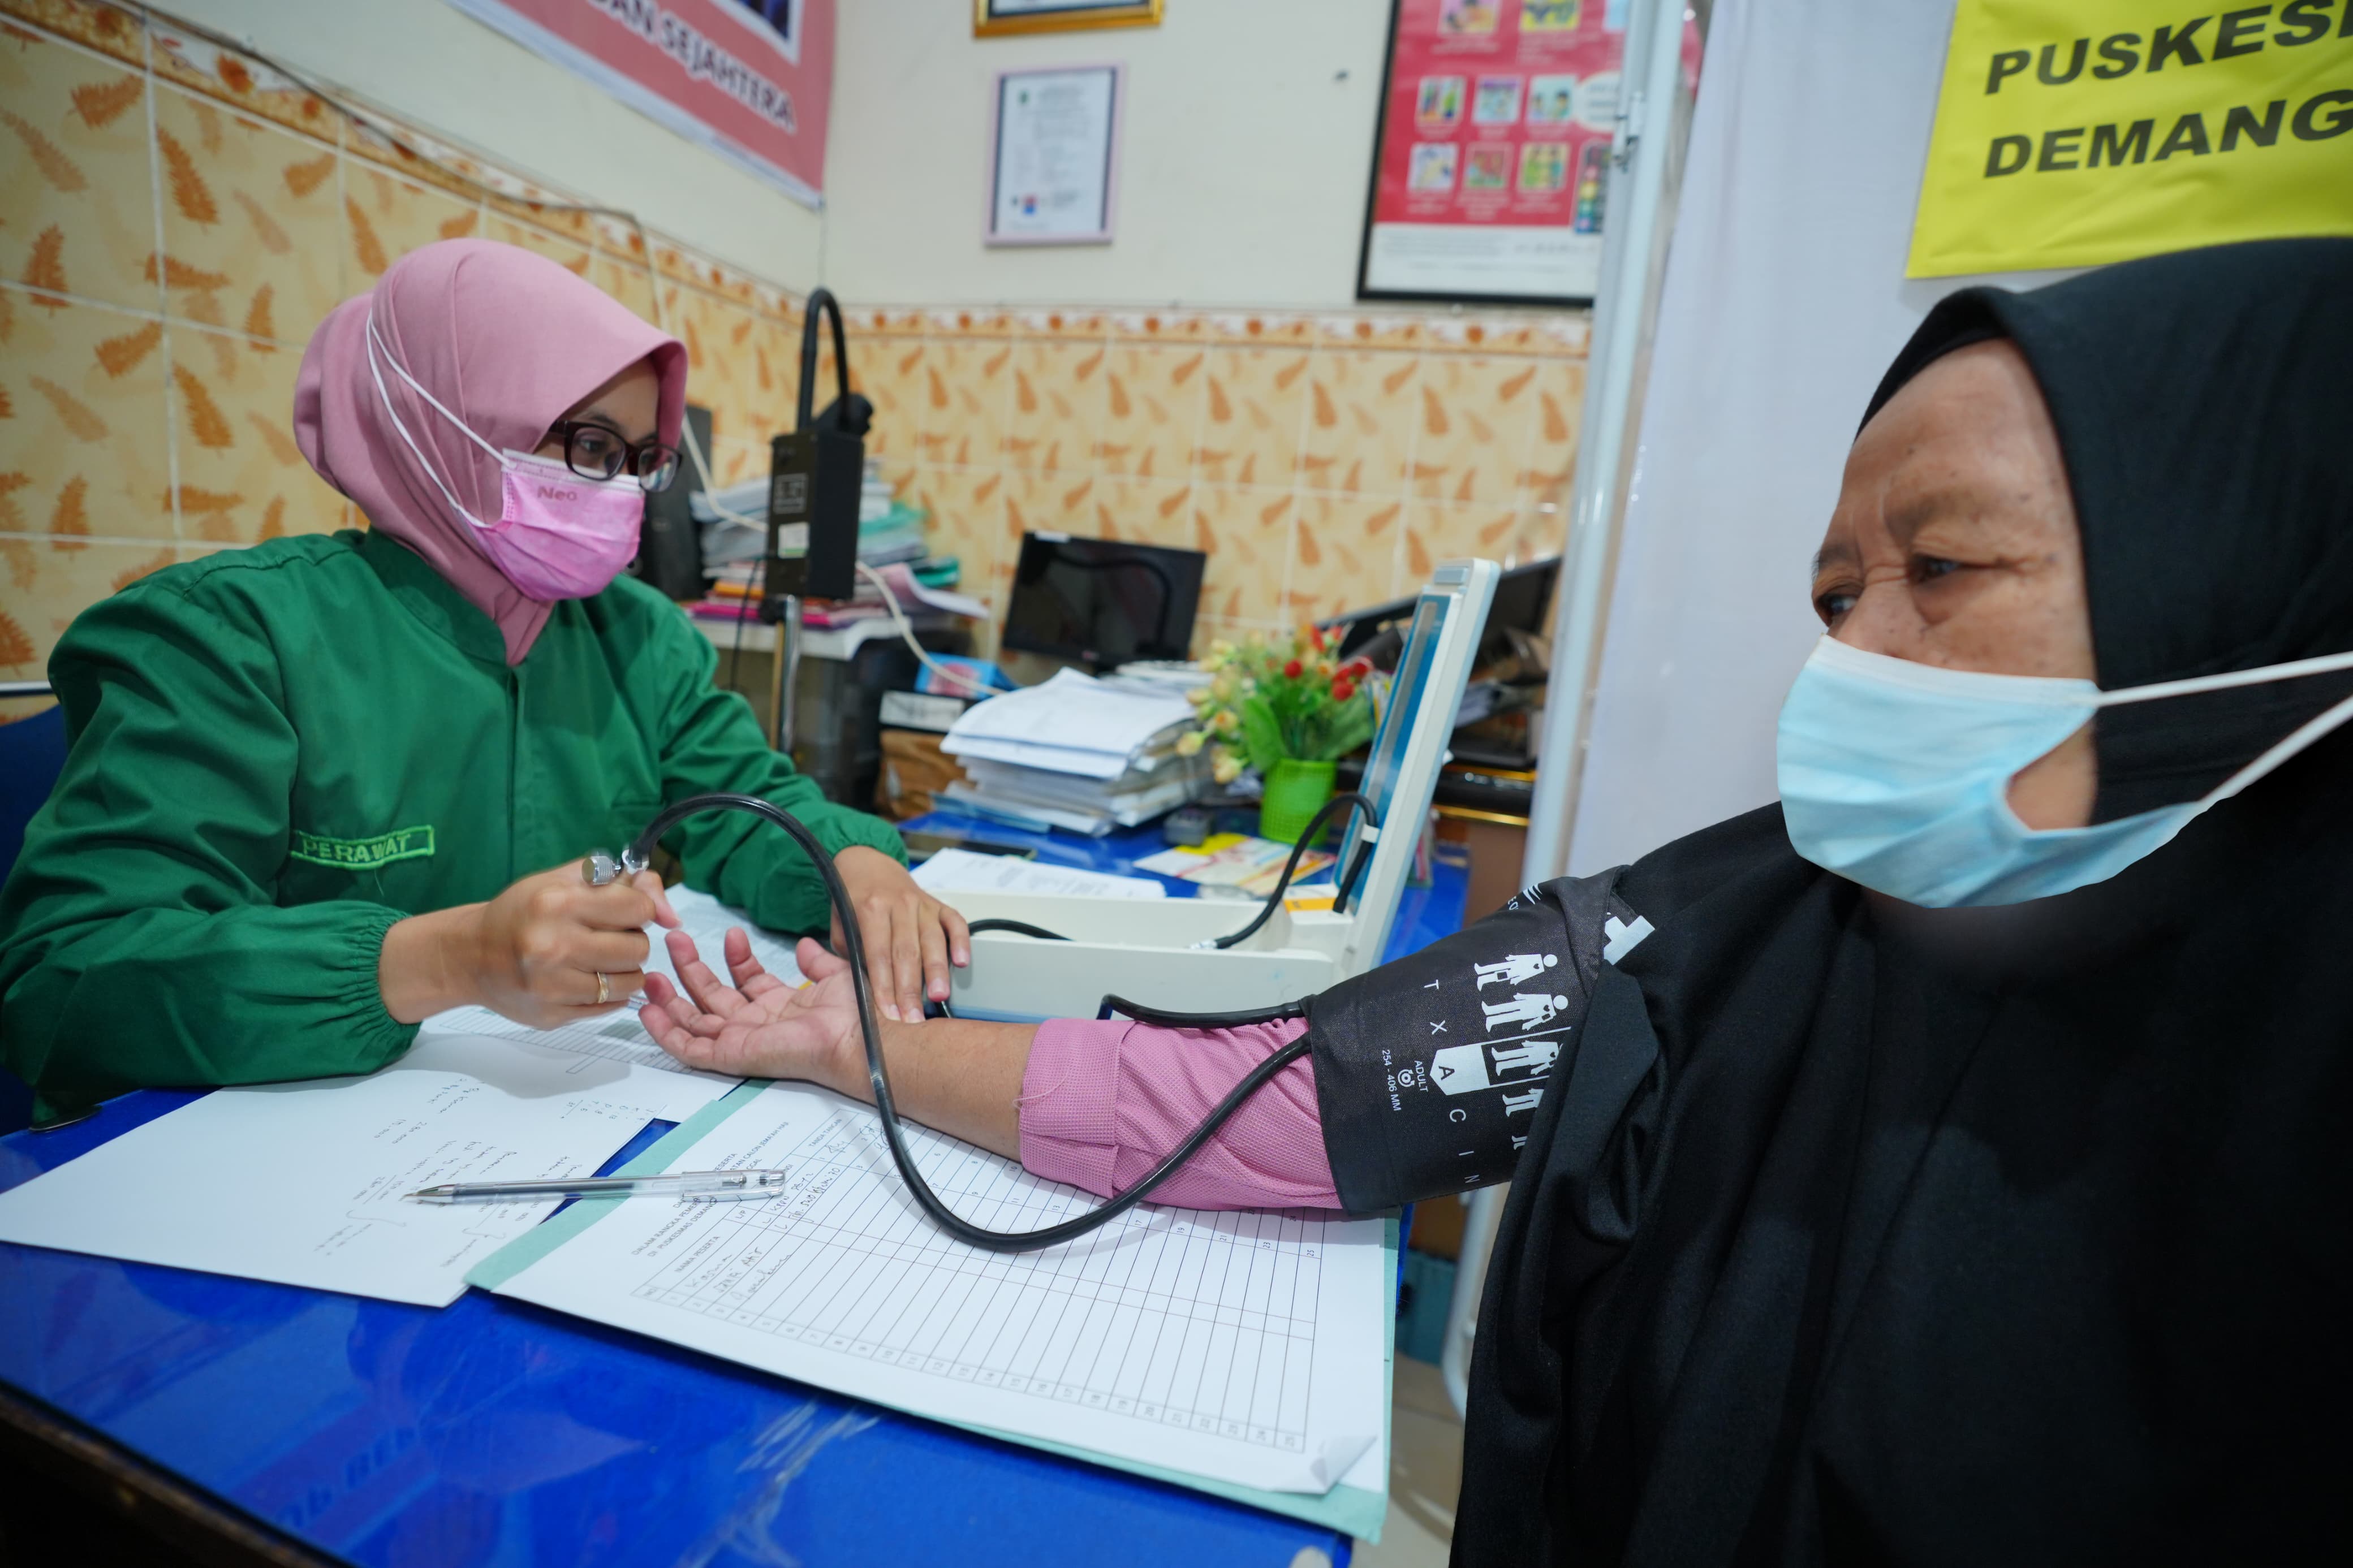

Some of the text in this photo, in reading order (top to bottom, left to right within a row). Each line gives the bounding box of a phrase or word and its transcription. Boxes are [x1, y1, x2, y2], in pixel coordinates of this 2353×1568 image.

[536, 486, 578, 501] Neo
[303, 833, 411, 862] PERAWAT
[1382, 1049, 1392, 1066] 254
[1387, 1074, 1397, 1092] 406
[1414, 1060, 1429, 1092] ADULT
[1390, 1094, 1402, 1111] MM
[1438, 1066, 1455, 1081] A
[1449, 1109, 1467, 1122] C
[631, 1237, 656, 1255] DALAM
[657, 1221, 693, 1250] PUSKESMAS
[674, 1236, 720, 1272] NAMA PESERTA
